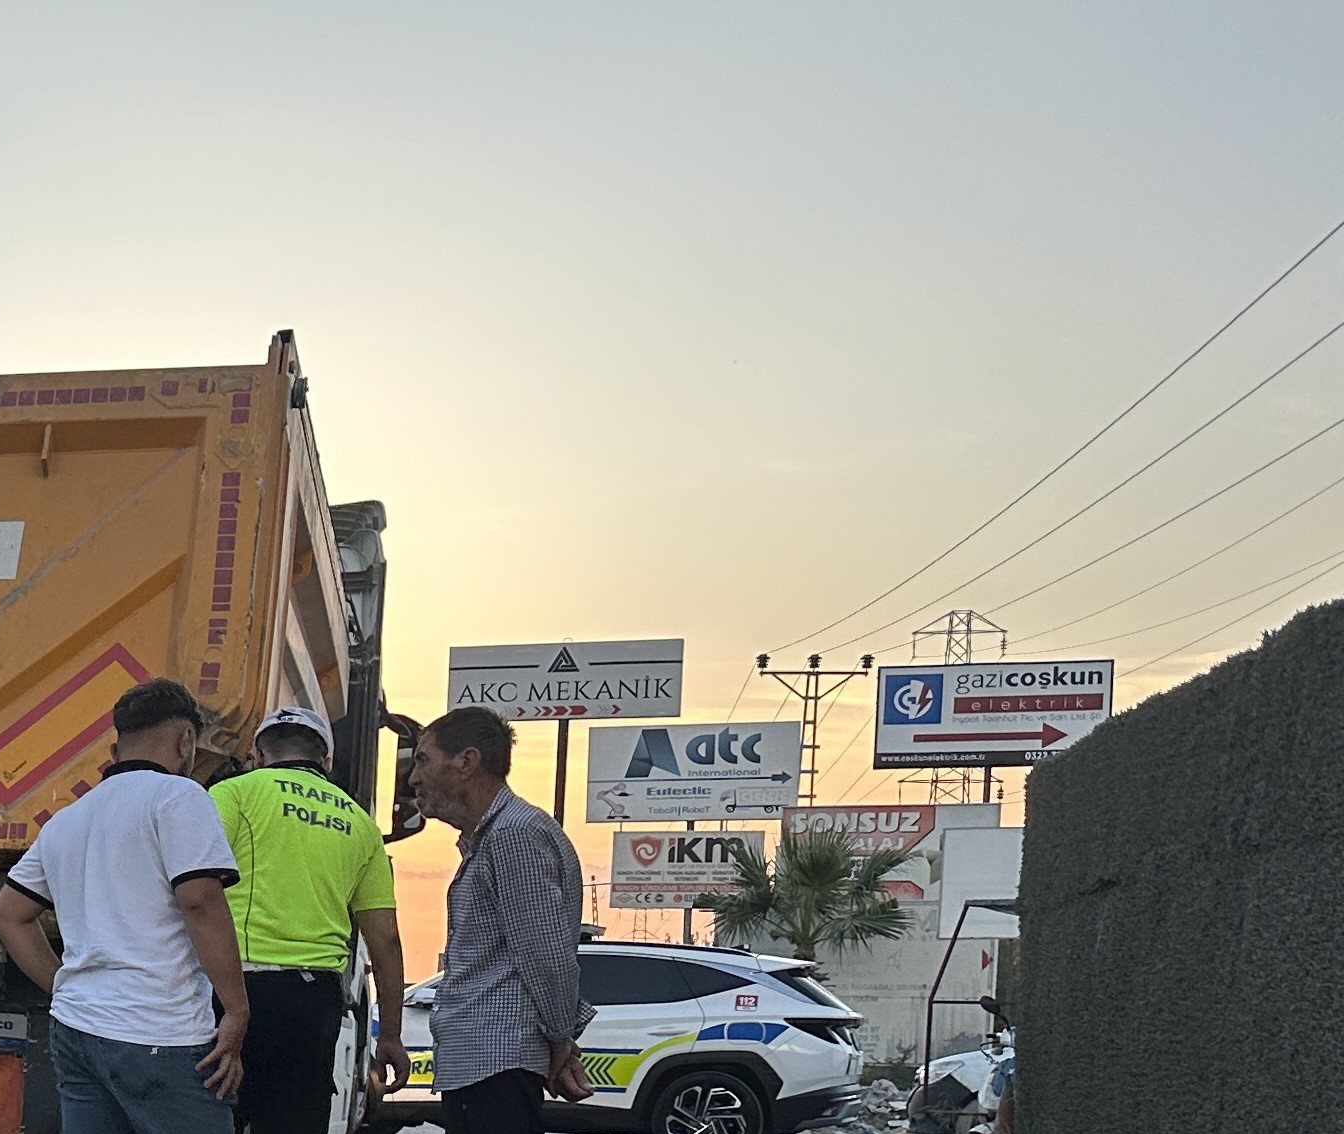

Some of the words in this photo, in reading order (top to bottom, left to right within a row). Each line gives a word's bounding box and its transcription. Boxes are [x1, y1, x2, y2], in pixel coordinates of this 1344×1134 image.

[457, 682, 518, 703] AKC
[527, 675, 674, 702] MEKANİK
[970, 698, 1084, 712] elektrik
[688, 767, 761, 778] International
[790, 811, 921, 833] SONSUZ
[739, 996, 755, 1006] 112
